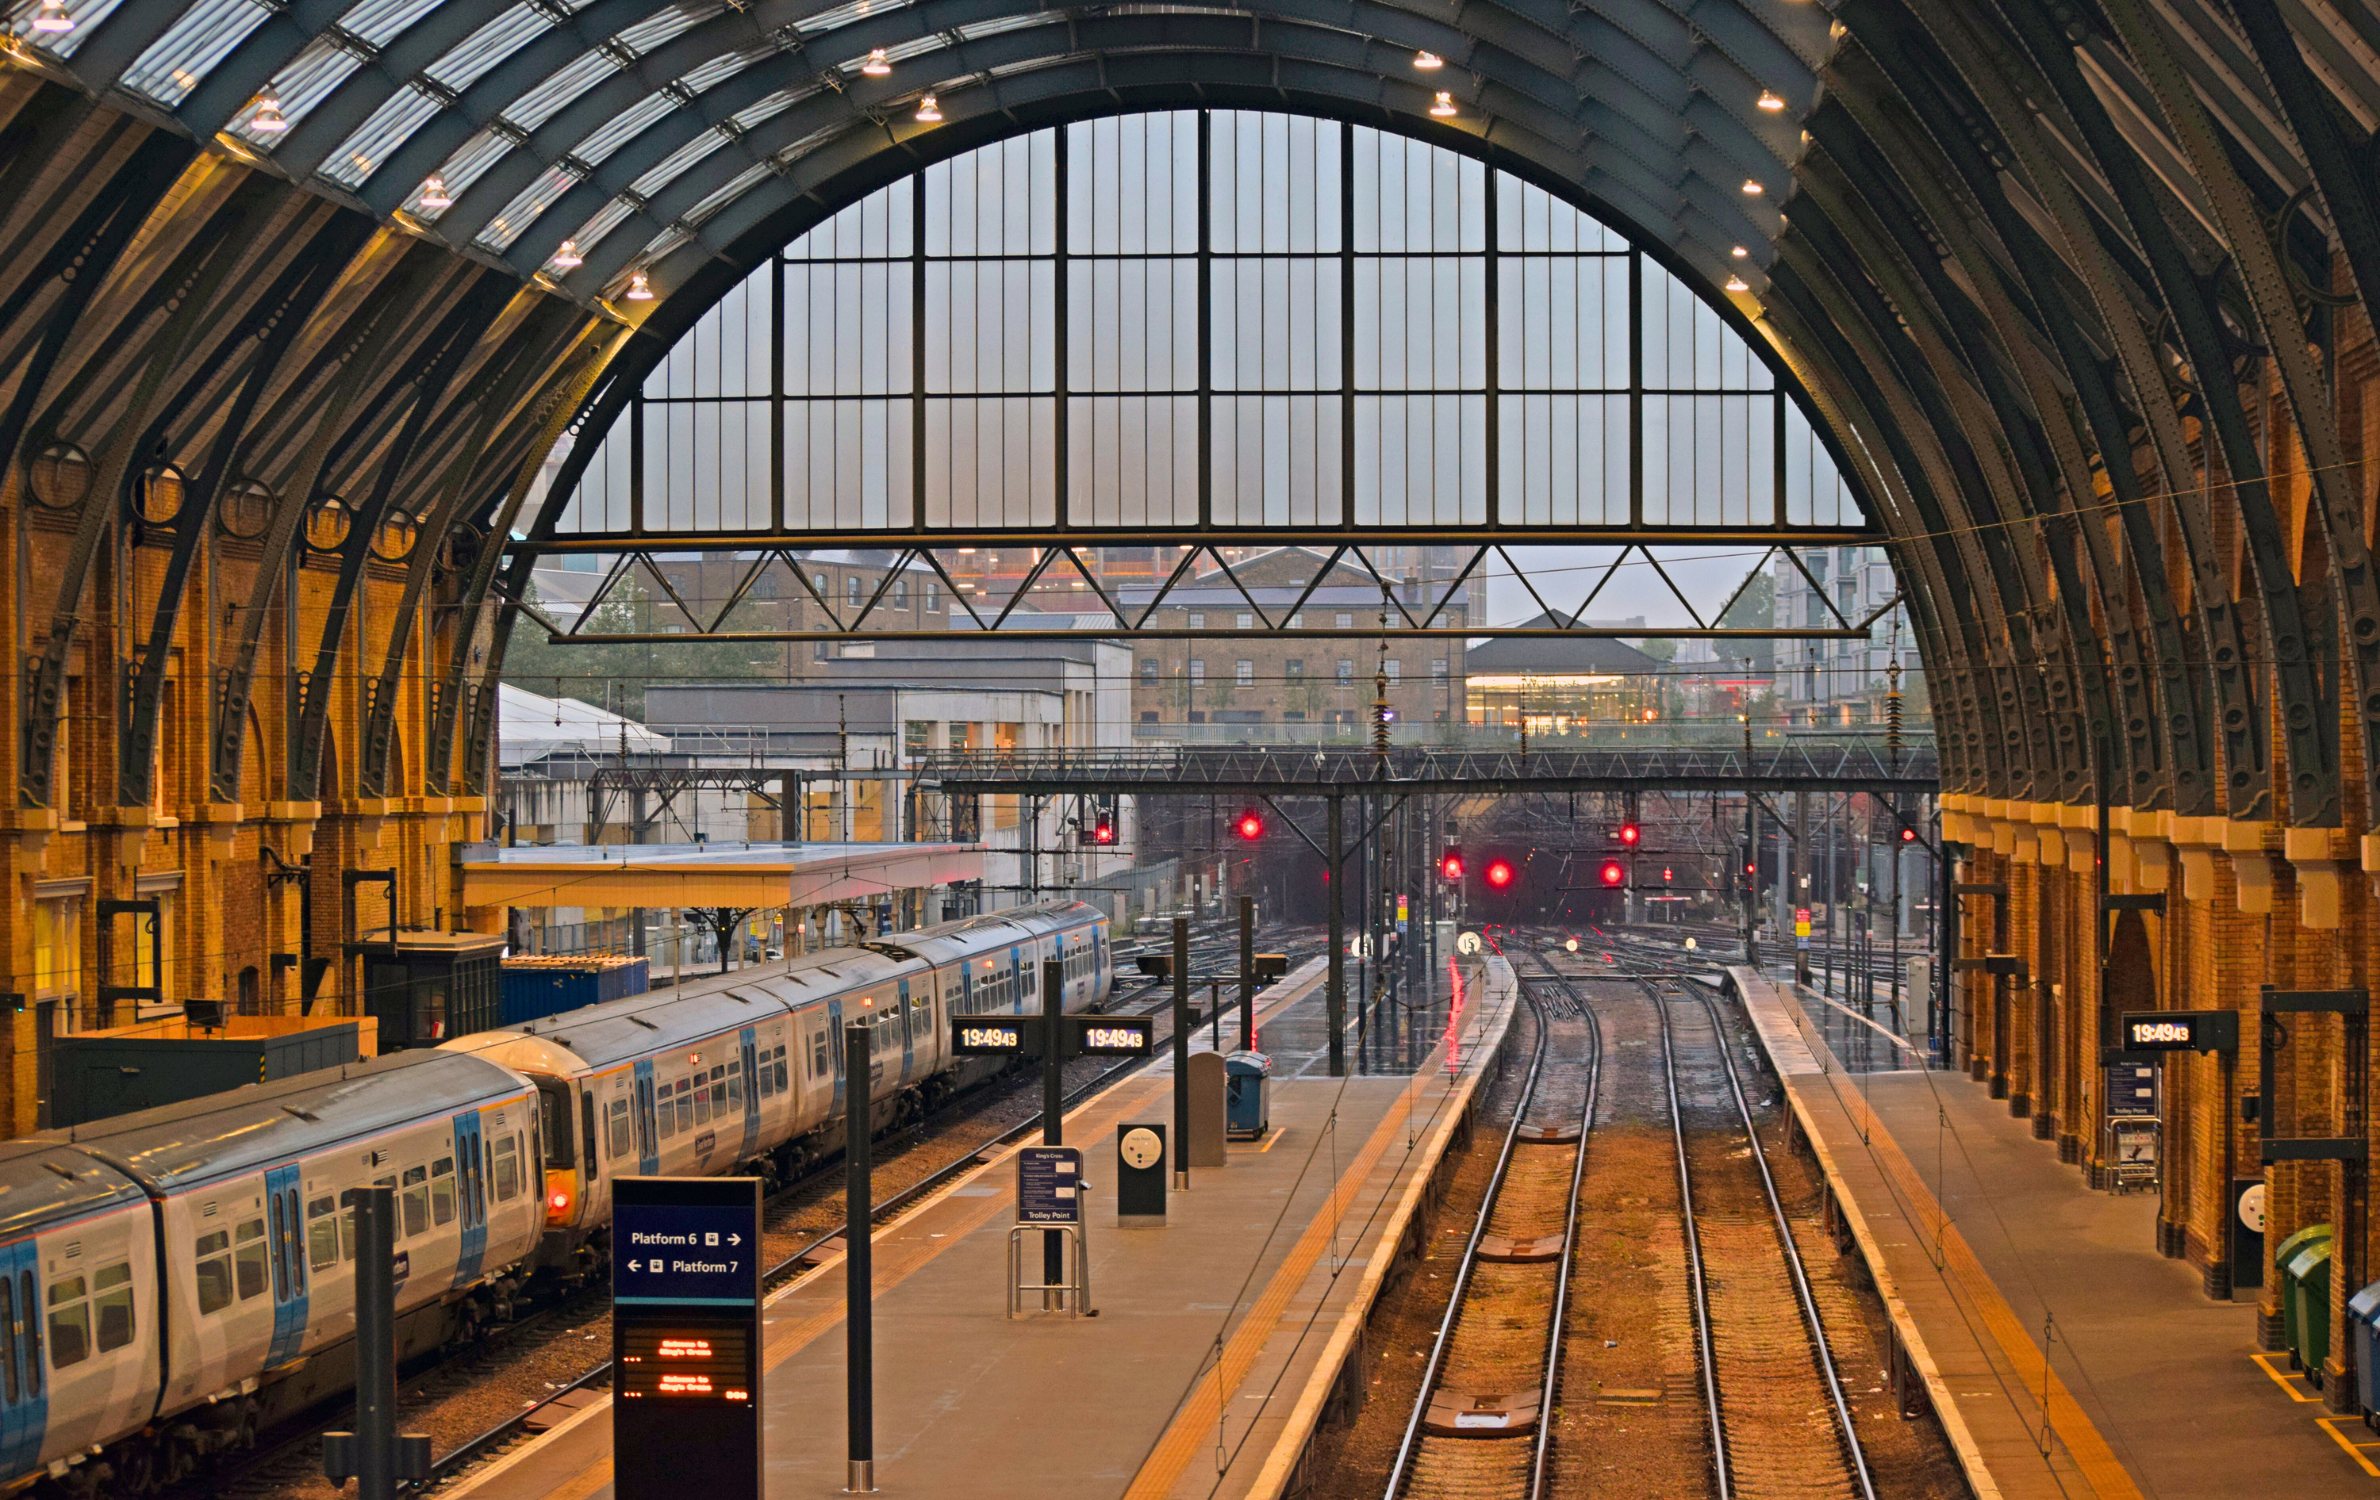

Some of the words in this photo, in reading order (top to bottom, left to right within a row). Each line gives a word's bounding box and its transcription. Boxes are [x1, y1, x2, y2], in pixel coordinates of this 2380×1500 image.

[1028, 1211, 1051, 1221] Trolley
[1052, 1211, 1071, 1219] Point
[632, 1232, 686, 1245] Platform
[688, 1233, 698, 1245] 6
[673, 1260, 727, 1273] Platform
[729, 1261, 739, 1273] 7
